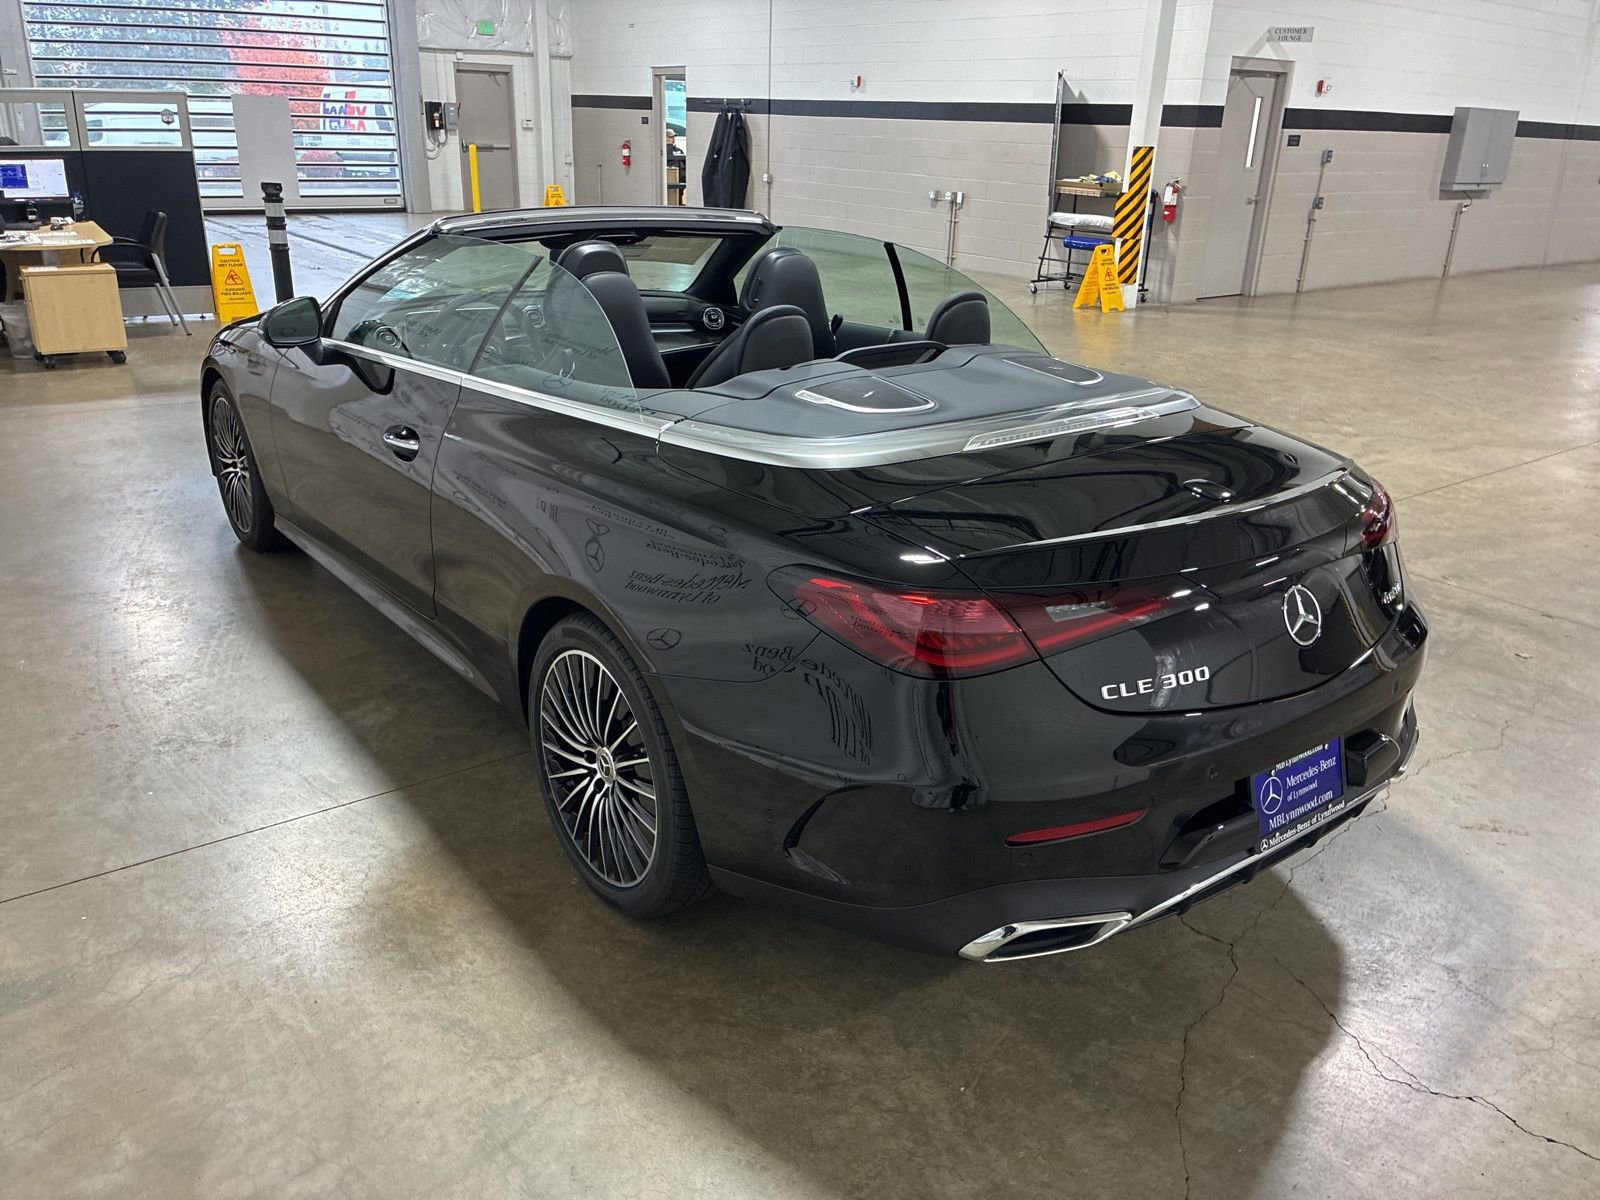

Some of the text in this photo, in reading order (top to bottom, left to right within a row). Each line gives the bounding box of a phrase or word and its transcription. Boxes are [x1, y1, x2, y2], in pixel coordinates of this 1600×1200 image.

[1101, 665, 1210, 700] CLE 300
[1286, 756, 1337, 789] Mercedes-Benz
[1292, 780, 1318, 799] Lynnwood
[1268, 789, 1333, 831] MBLynnwood.com
[1269, 818, 1311, 848] Mercedes-Benz
[1316, 800, 1345, 822] Lynnwood
